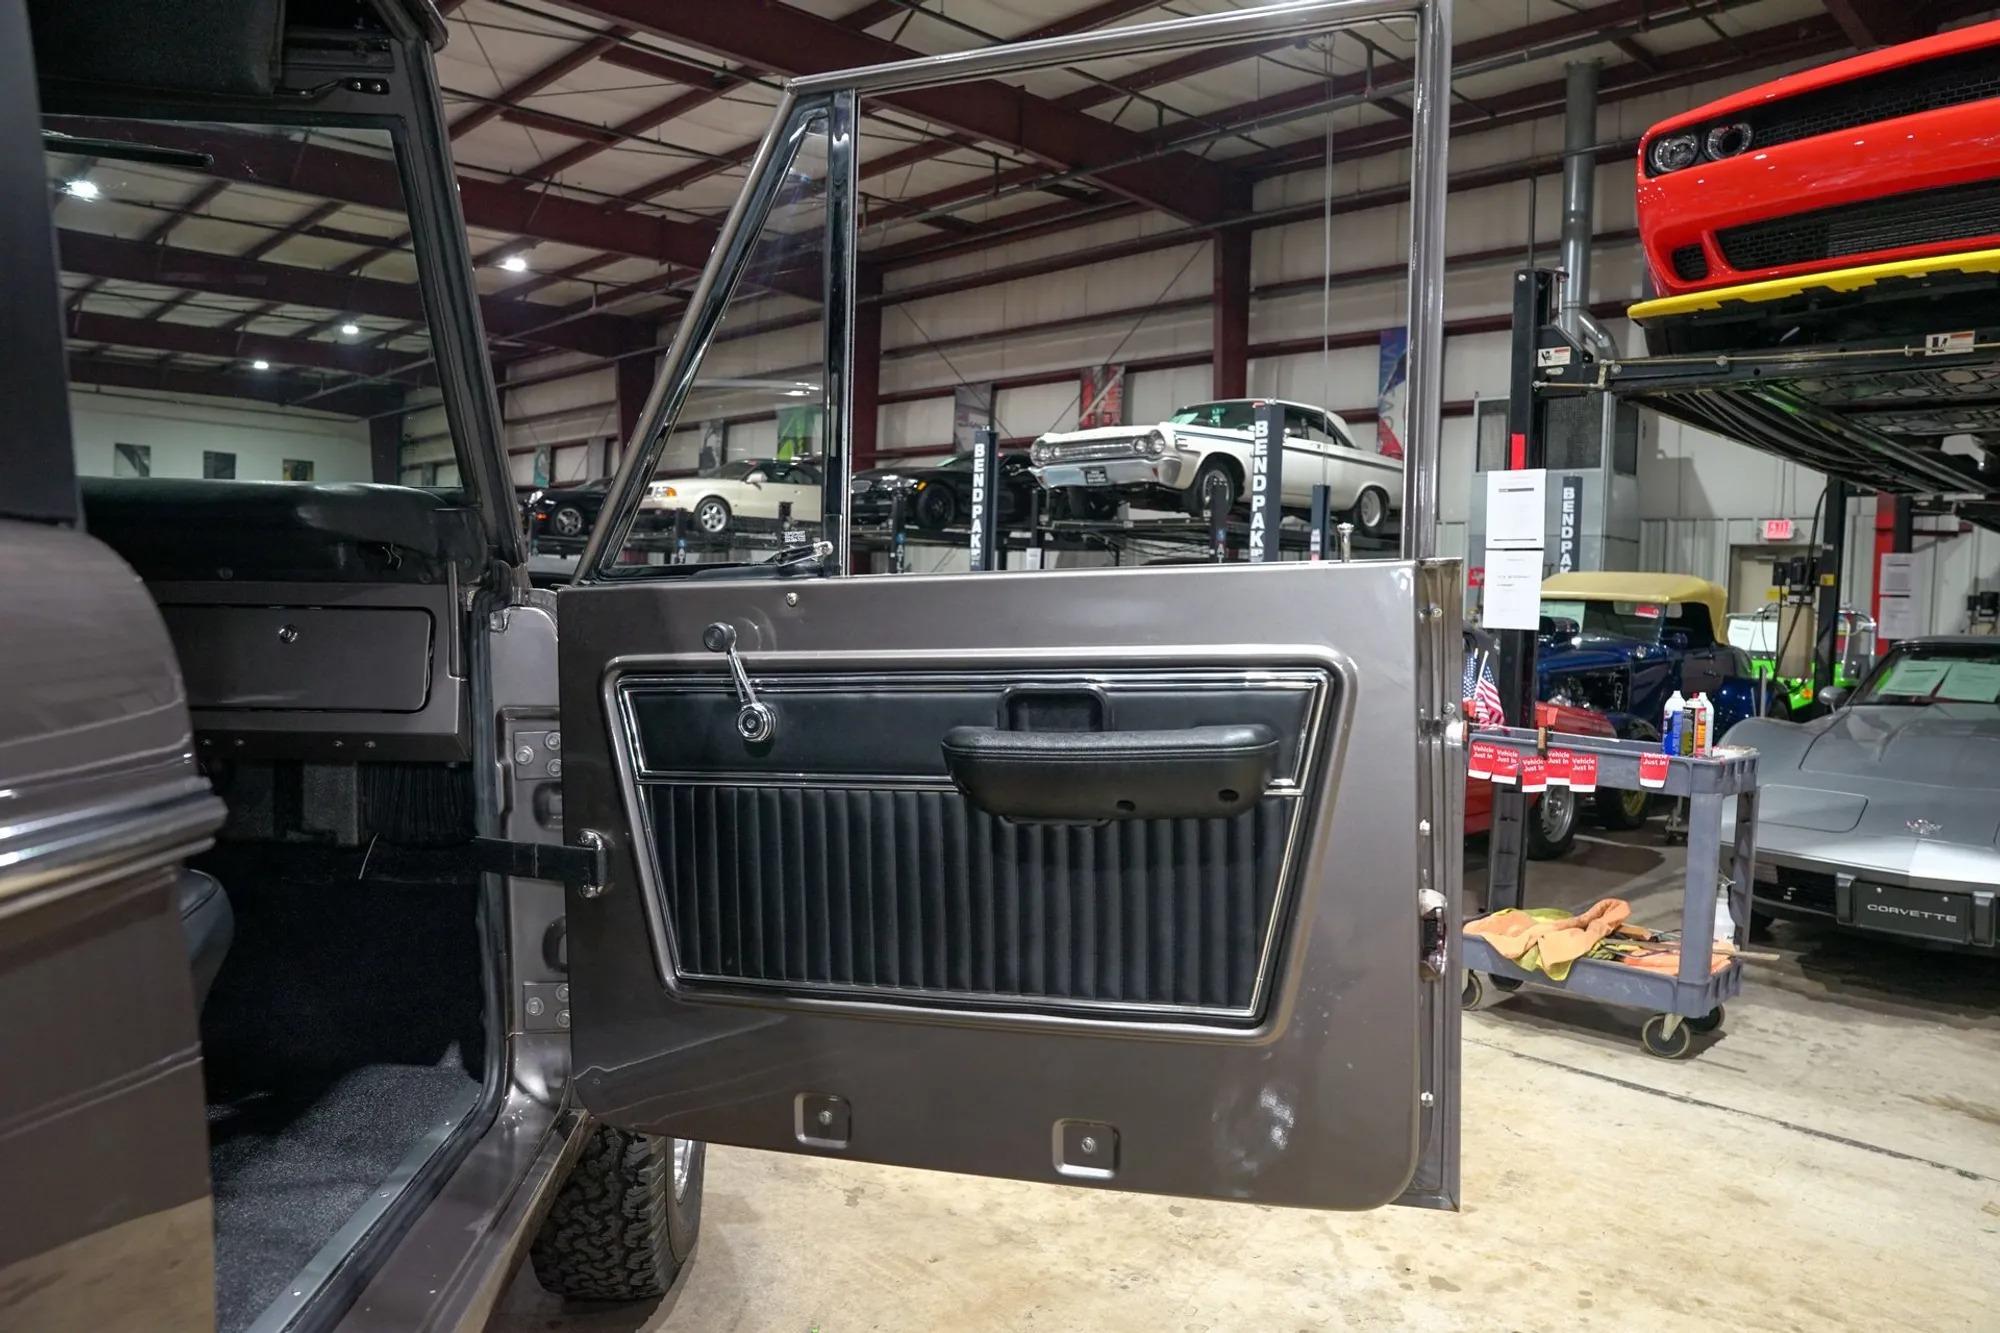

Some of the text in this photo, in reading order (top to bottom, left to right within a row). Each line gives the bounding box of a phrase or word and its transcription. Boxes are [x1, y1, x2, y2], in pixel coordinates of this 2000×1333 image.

[1250, 420, 1269, 547] BENDPAK
[970, 443, 985, 549] BENDPAK
[1472, 745, 1494, 754] Vehicle
[1496, 750, 1518, 758] Vehicle
[1867, 904, 1957, 923] CORVETTE
